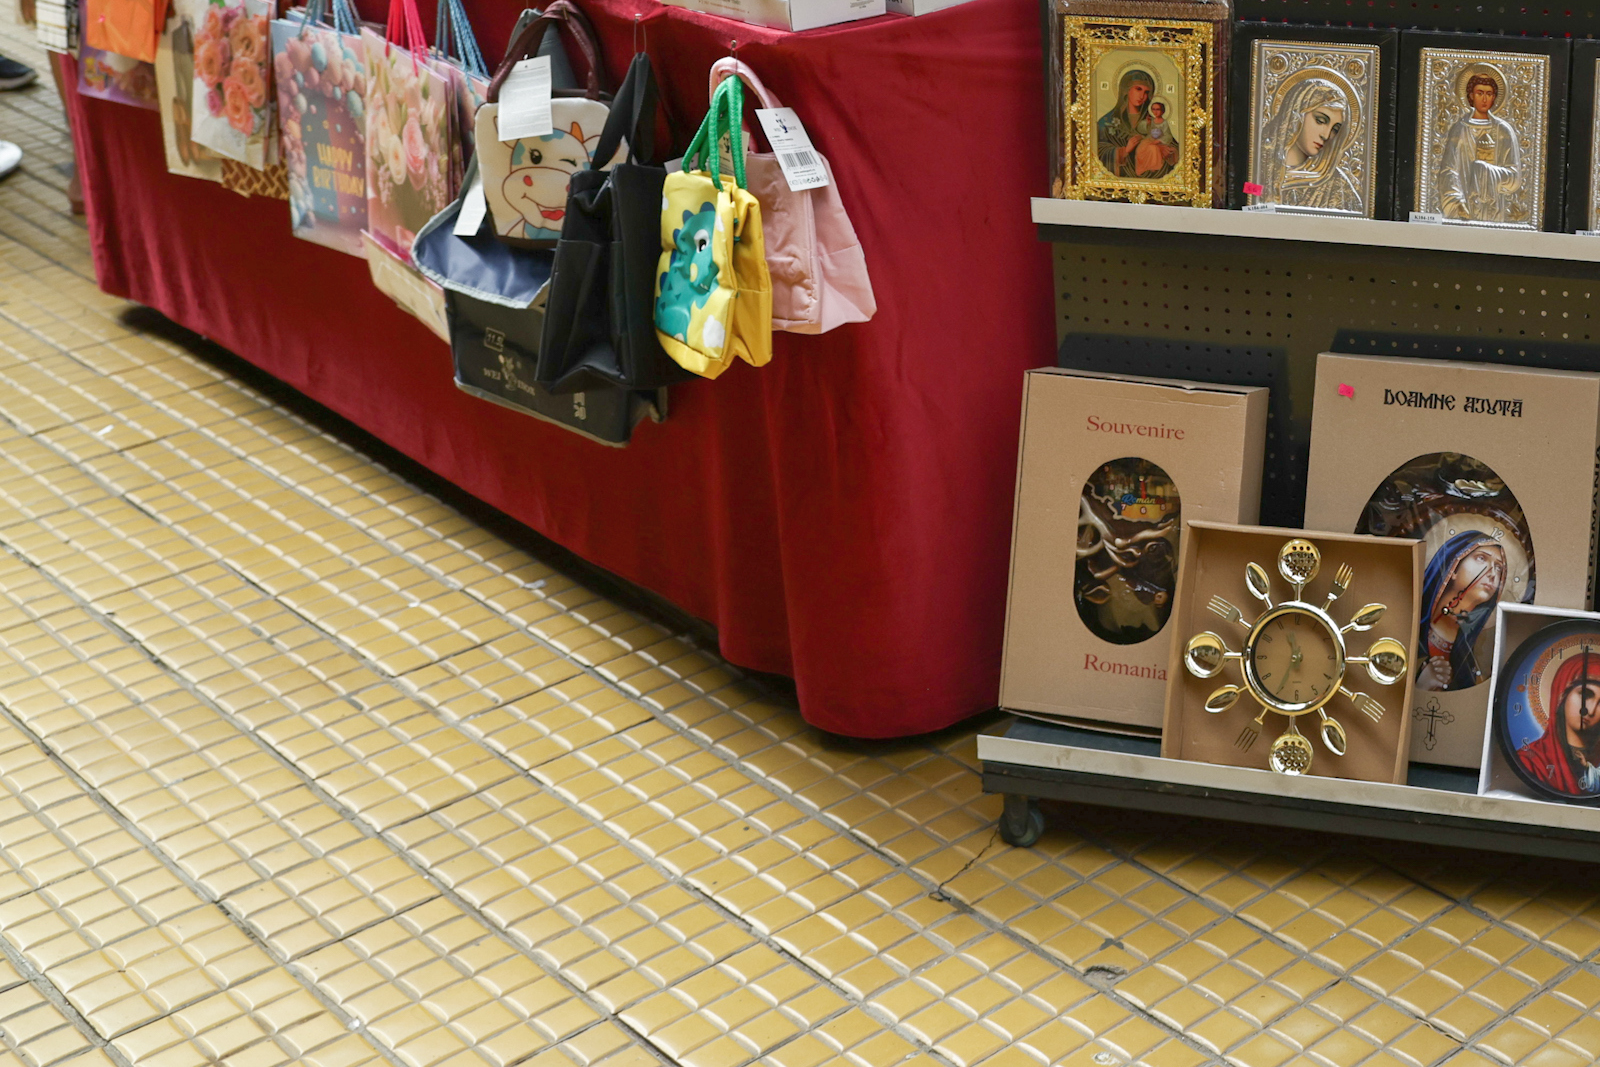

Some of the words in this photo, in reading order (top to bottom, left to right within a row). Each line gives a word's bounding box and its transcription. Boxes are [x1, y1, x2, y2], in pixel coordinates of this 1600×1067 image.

[317, 142, 353, 172] HAPPY
[1383, 388, 1456, 411] DOAMNE
[1463, 396, 1524, 418] AJUTĂ
[1086, 415, 1186, 441] Souvenire
[1491, 527, 1504, 542] 12
[1586, 575, 1593, 601] IN
[1083, 653, 1168, 681] Romania
[1523, 673, 1539, 686] 10
[1513, 702, 1523, 717] 9
[1521, 737, 1530, 751] 8
[1546, 765, 1555, 779] 7
